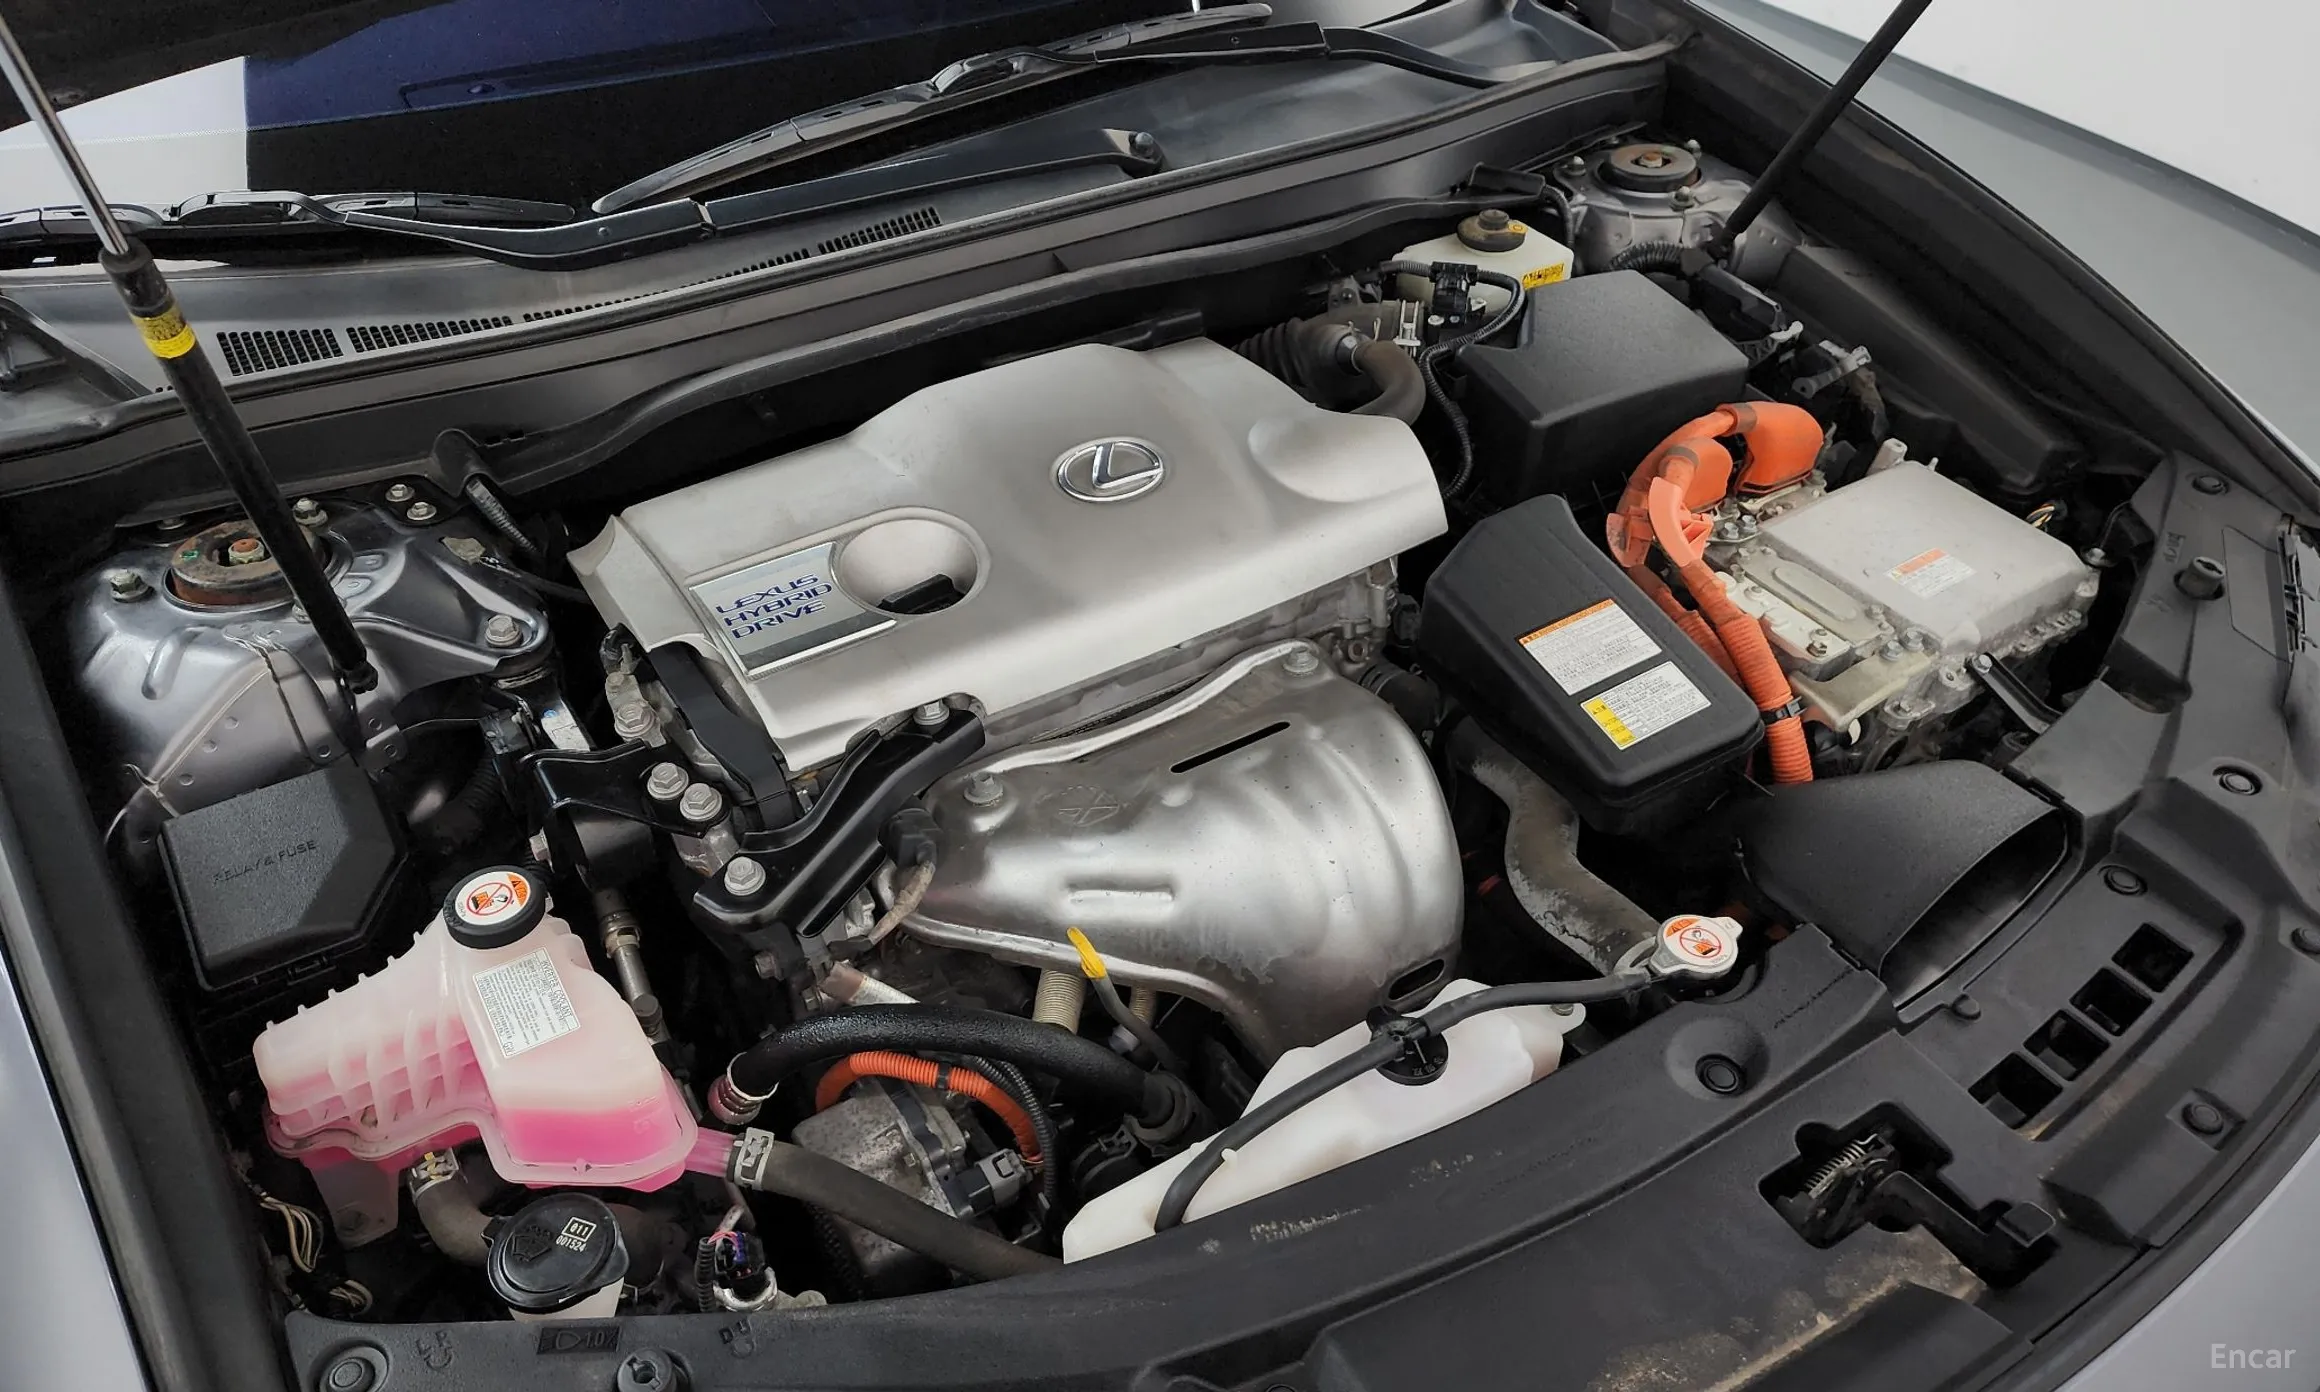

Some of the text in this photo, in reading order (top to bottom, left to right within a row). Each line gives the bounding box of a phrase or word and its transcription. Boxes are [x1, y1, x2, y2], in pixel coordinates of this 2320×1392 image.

[715, 573, 819, 614] LEXUS
[723, 582, 833, 627] HYBRID
[731, 599, 826, 640] DRIVE
[278, 840, 317, 861] FUSE
[556, 1235, 587, 1253] 001524
